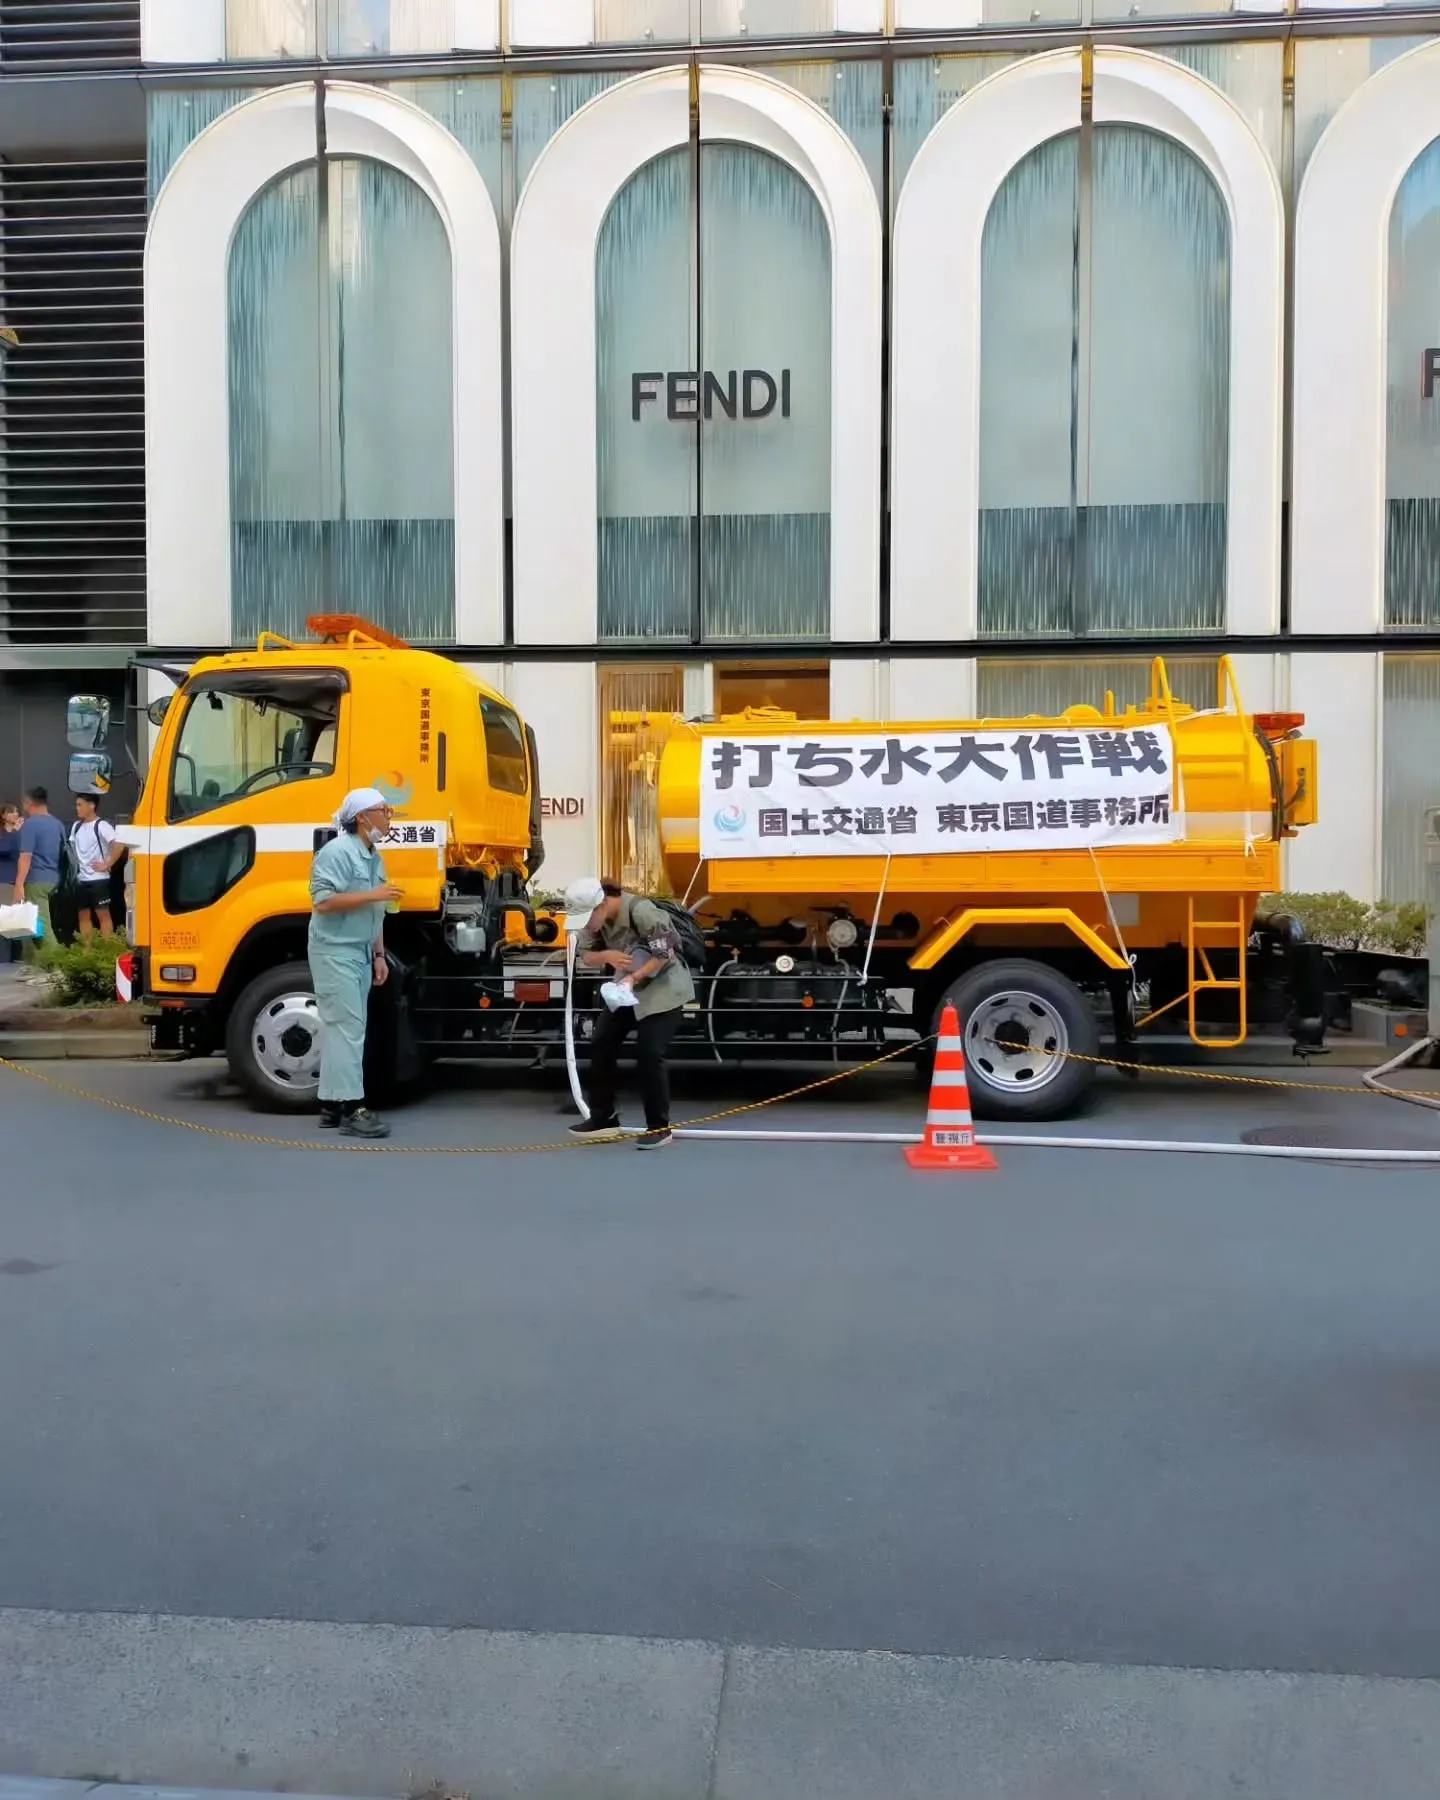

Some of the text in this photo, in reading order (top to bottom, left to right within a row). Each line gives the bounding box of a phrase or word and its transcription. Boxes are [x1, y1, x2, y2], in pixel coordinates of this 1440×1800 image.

[632, 369, 790, 421] FENDI
[419, 687, 431, 764] 東京国道事務所
[711, 731, 1169, 790] 打ち水大作戦
[540, 797, 584, 815] ENDI
[758, 794, 1170, 837] 国土交通省 東京国道事務所
[377, 825, 436, 844] 交通省
